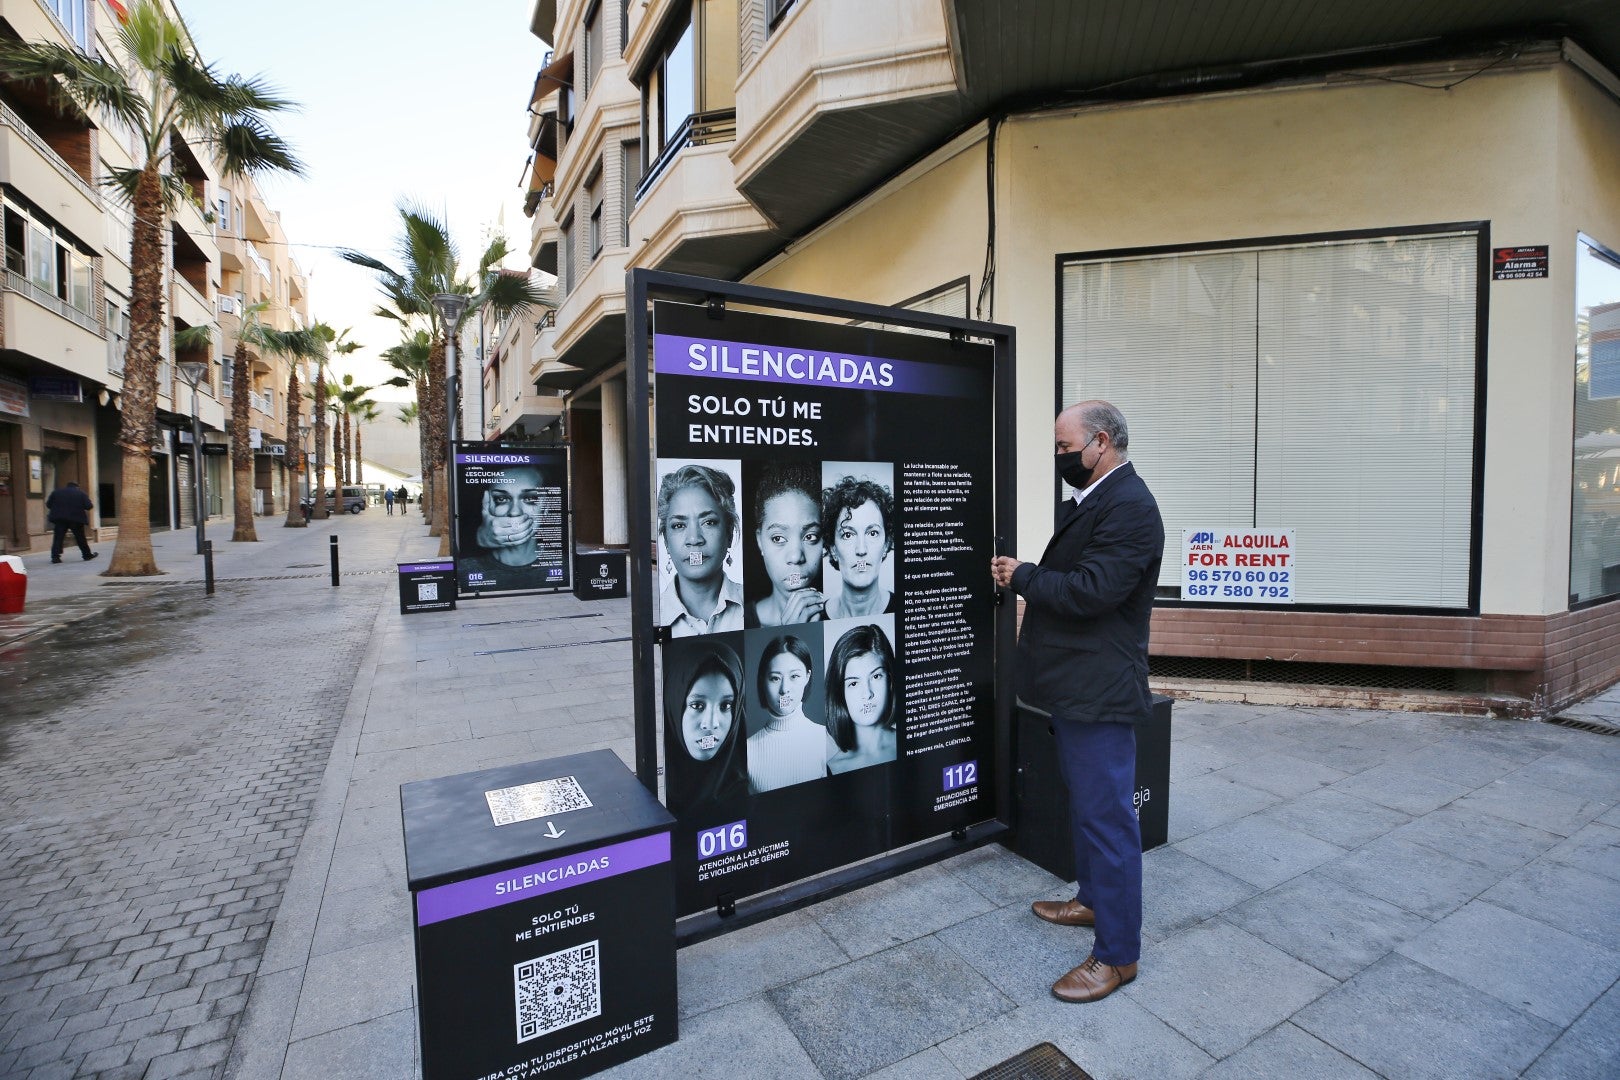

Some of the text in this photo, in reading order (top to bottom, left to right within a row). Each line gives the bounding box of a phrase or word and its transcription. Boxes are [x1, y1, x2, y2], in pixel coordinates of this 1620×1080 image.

[688, 343, 894, 387] SILENCIADAS
[688, 395, 822, 420] SOLO TÚ ME
[689, 424, 818, 446] ENTIENDES.
[1190, 532, 1213, 543] API
[1224, 535, 1289, 548] ALQUILA
[1189, 554, 1289, 566] FOR RENT
[1189, 570, 1289, 582] 96 570 60 02
[1189, 585, 1289, 597] 687 580 792
[946, 764, 976, 787] 112
[934, 797, 968, 811] EMERGENCIA
[936, 789, 969, 803] SITUACIONES
[700, 824, 744, 856] 016
[698, 856, 735, 872] ATENCIÓN
[744, 850, 756, 859] LAS
[758, 840, 789, 855] VÍCTIMAS
[699, 849, 790, 881] DE VIOLENCIA DE GÉNERO
[496, 856, 609, 894] SILENCIADAS
[532, 904, 579, 925] SOLO TÚ
[516, 912, 595, 942] ME ENTIENDES
[507, 1061, 528, 1074] CON
[531, 1056, 543, 1065] TU
[546, 1035, 602, 1060] DISPOSITIVO
[605, 1023, 632, 1038] MÓVIL
[634, 1014, 654, 1028] ESTE
[521, 1071, 527, 1079] Y
[530, 1052, 578, 1077] AYÚDALES
[590, 1037, 619, 1053] ALZAR
[622, 1032, 632, 1041] SU
[635, 1025, 652, 1036] VOZ
